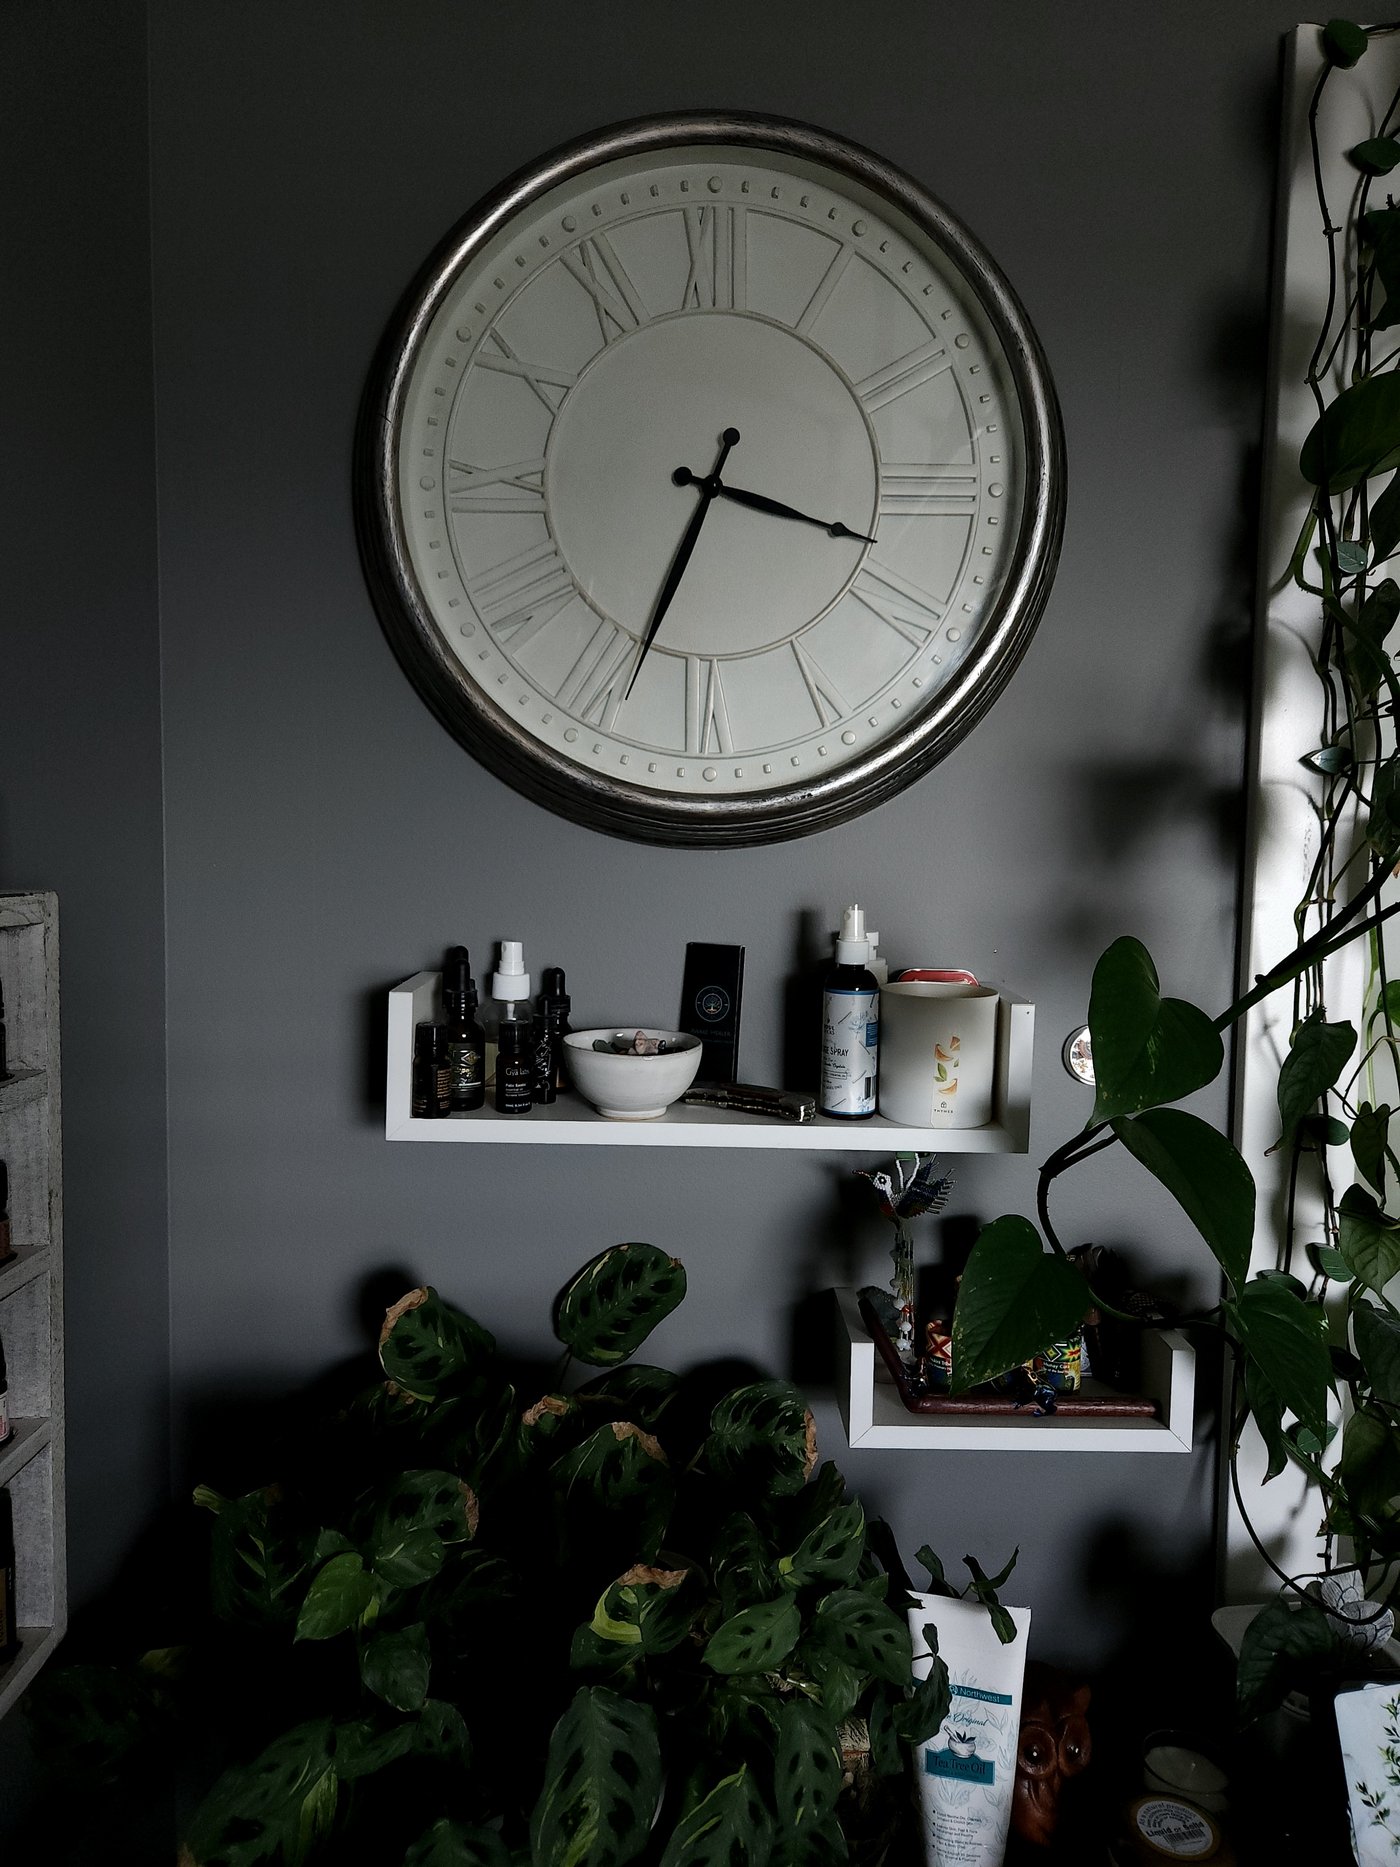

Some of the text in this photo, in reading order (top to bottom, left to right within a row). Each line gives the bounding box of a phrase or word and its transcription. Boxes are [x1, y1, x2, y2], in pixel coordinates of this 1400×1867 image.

[560, 234, 650, 345] XI
[682, 206, 747, 310] XII
[475, 327, 579, 415] X
[855, 337, 953, 413] II
[448, 459, 545, 513] IX
[880, 462, 977, 516] III
[466, 540, 579, 656] VIII
[849, 558, 947, 648] IV
[555, 618, 644, 731] VII
[685, 657, 734, 754] VI
[794, 637, 852, 728] V
[830, 1047, 849, 1057] SPRAY
[954, 1712, 989, 1727] Original
[959, 1687, 1000, 1703] Northwest
[933, 1756, 948, 1769] Tea
[950, 1759, 969, 1771] Tree
[970, 1762, 985, 1775] Oil
[1146, 1827, 1173, 1837] Liquid
[1182, 1821, 1205, 1831] Solid
